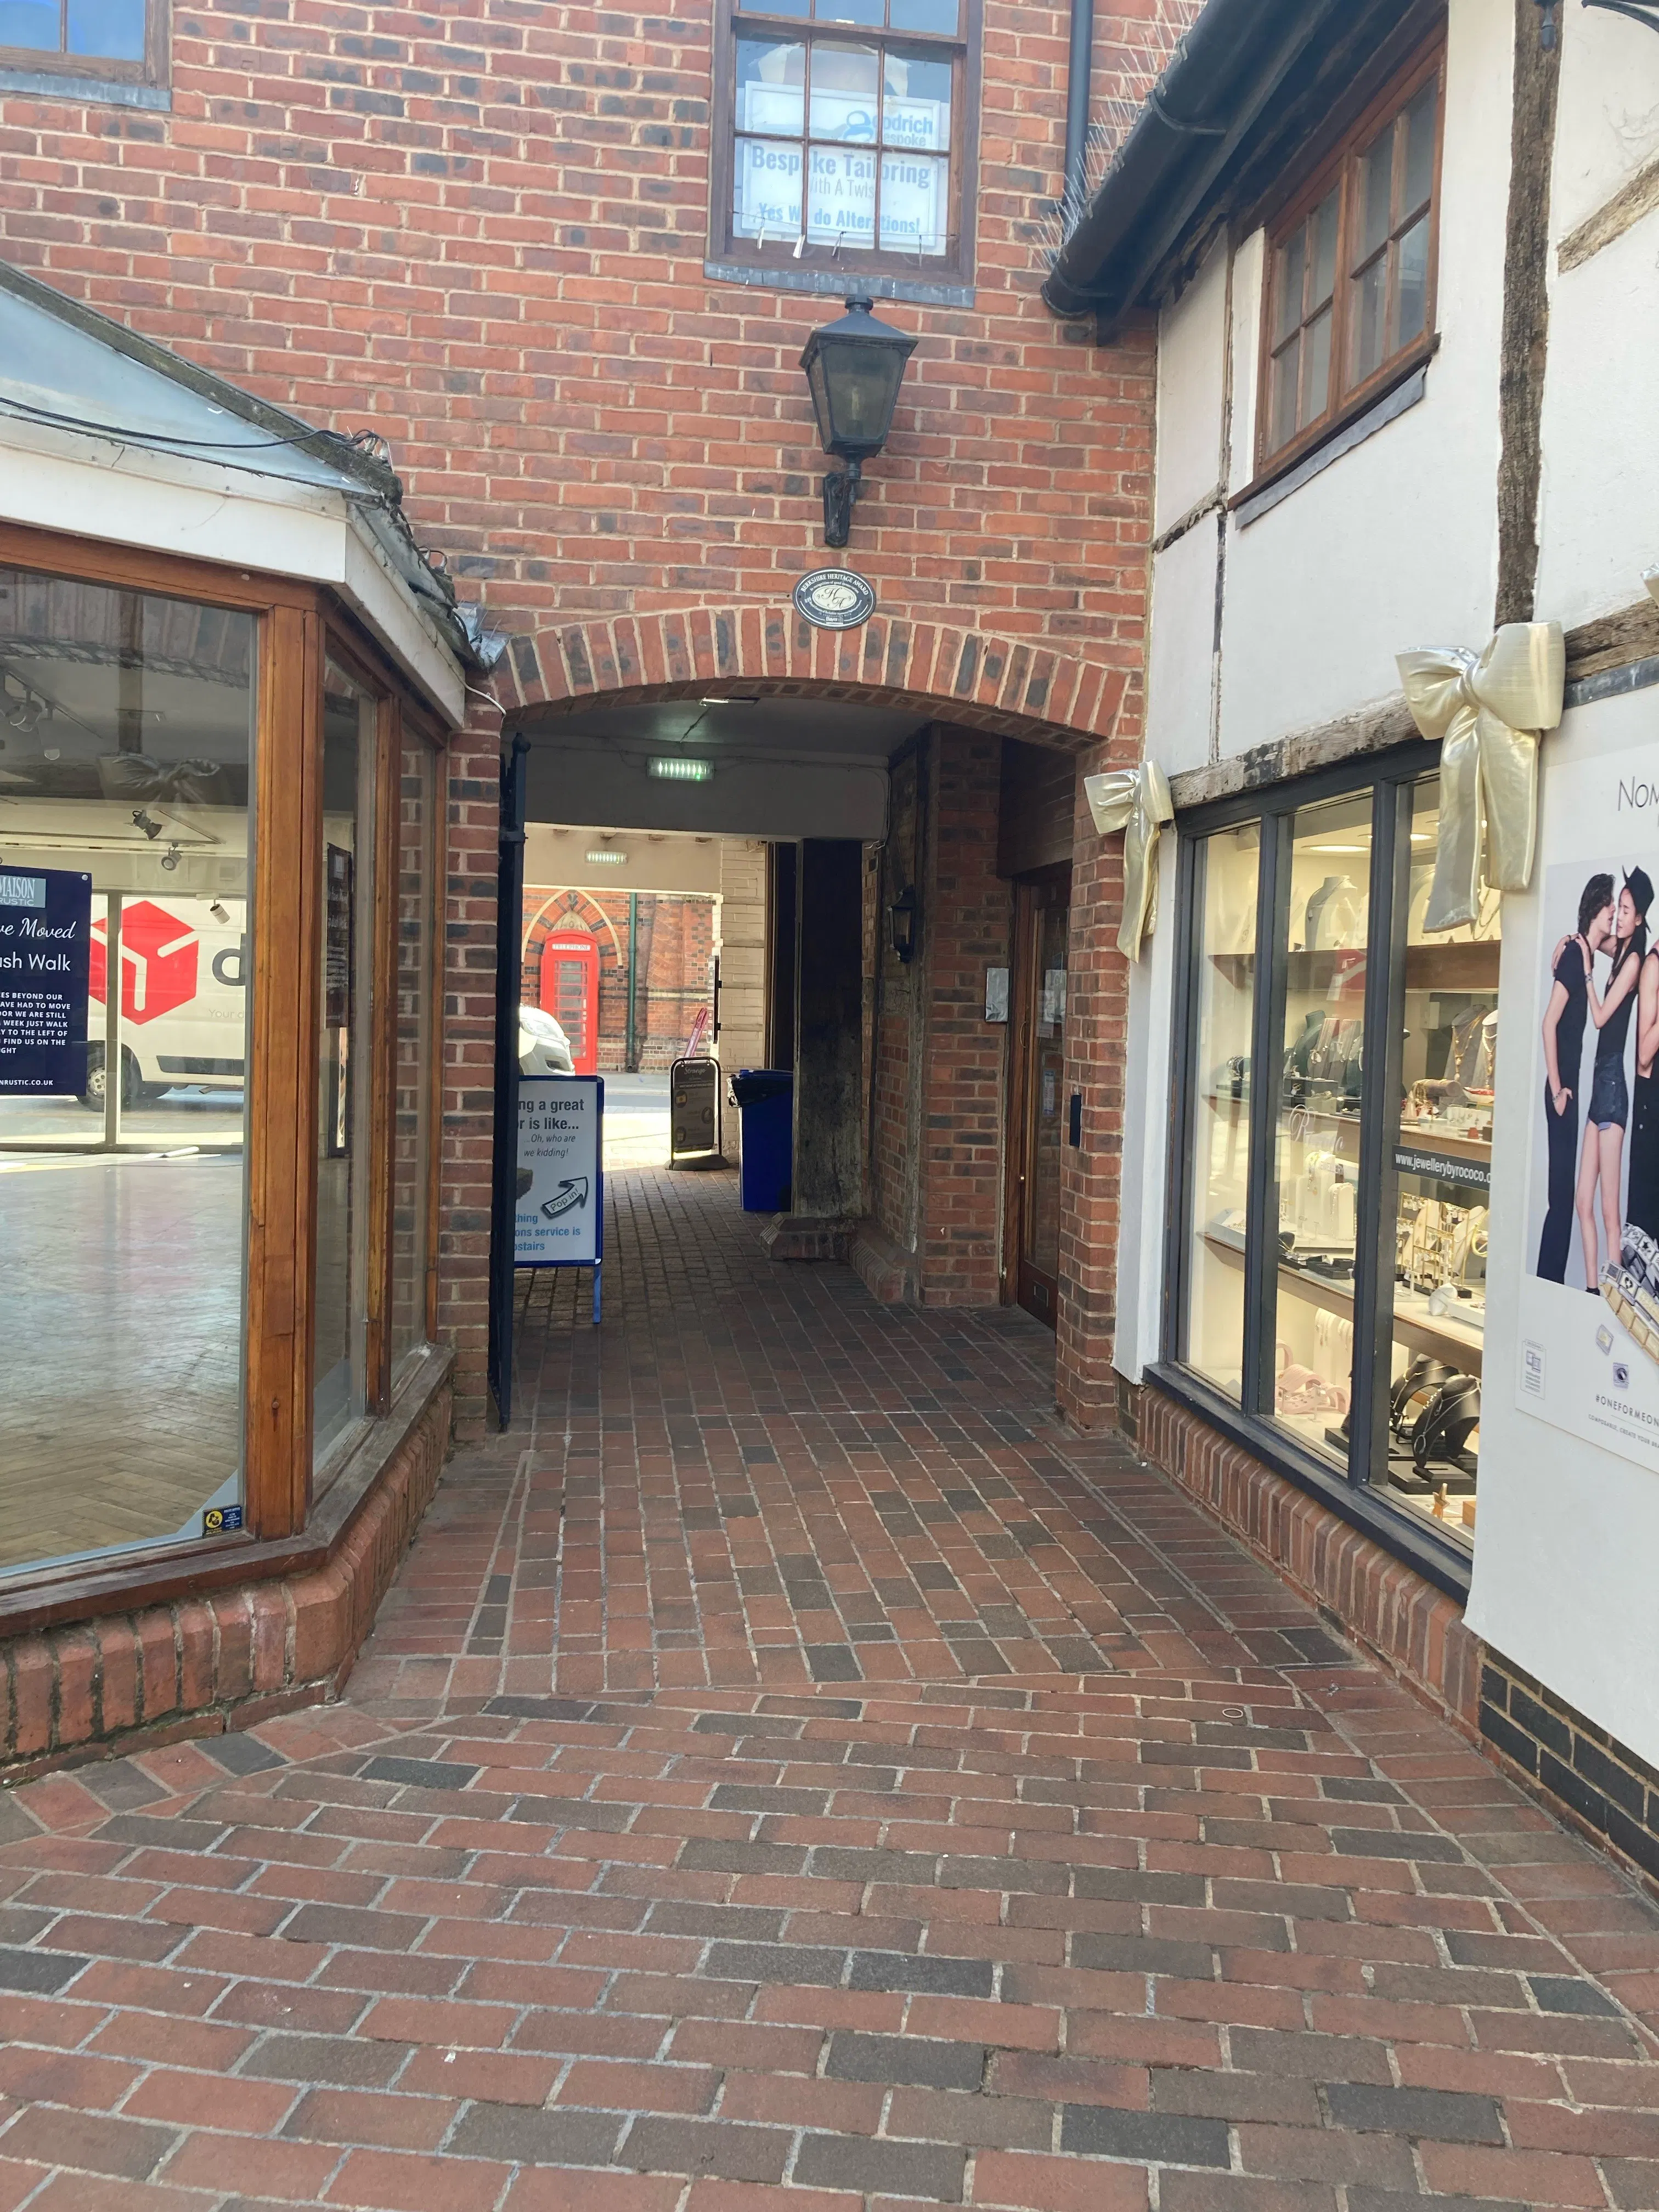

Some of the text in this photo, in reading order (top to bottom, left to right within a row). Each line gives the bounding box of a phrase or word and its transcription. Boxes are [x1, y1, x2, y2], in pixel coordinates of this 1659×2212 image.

[752, 145, 836, 176] Bespke
[834, 178, 843, 196] A
[759, 202, 783, 221] Yes
[814, 208, 831, 225] do
[836, 210, 920, 234] Altertions!
[800, 573, 869, 595] BERKSHIRE HERITAGE AWARD
[19, 917, 77, 939] Moved
[29, 953, 71, 971] Walk
[209, 1008, 234, 1018] Your
[539, 1101, 546, 1110] a
[550, 1099, 584, 1113] great
[529, 1117, 540, 1130] is
[544, 1117, 579, 1130] like...
[546, 1133, 562, 1142] who
[537, 1147, 569, 1159] kidding!
[550, 1187, 580, 1211] Pop in!
[534, 1227, 569, 1237] service
[572, 1226, 580, 1235] is
